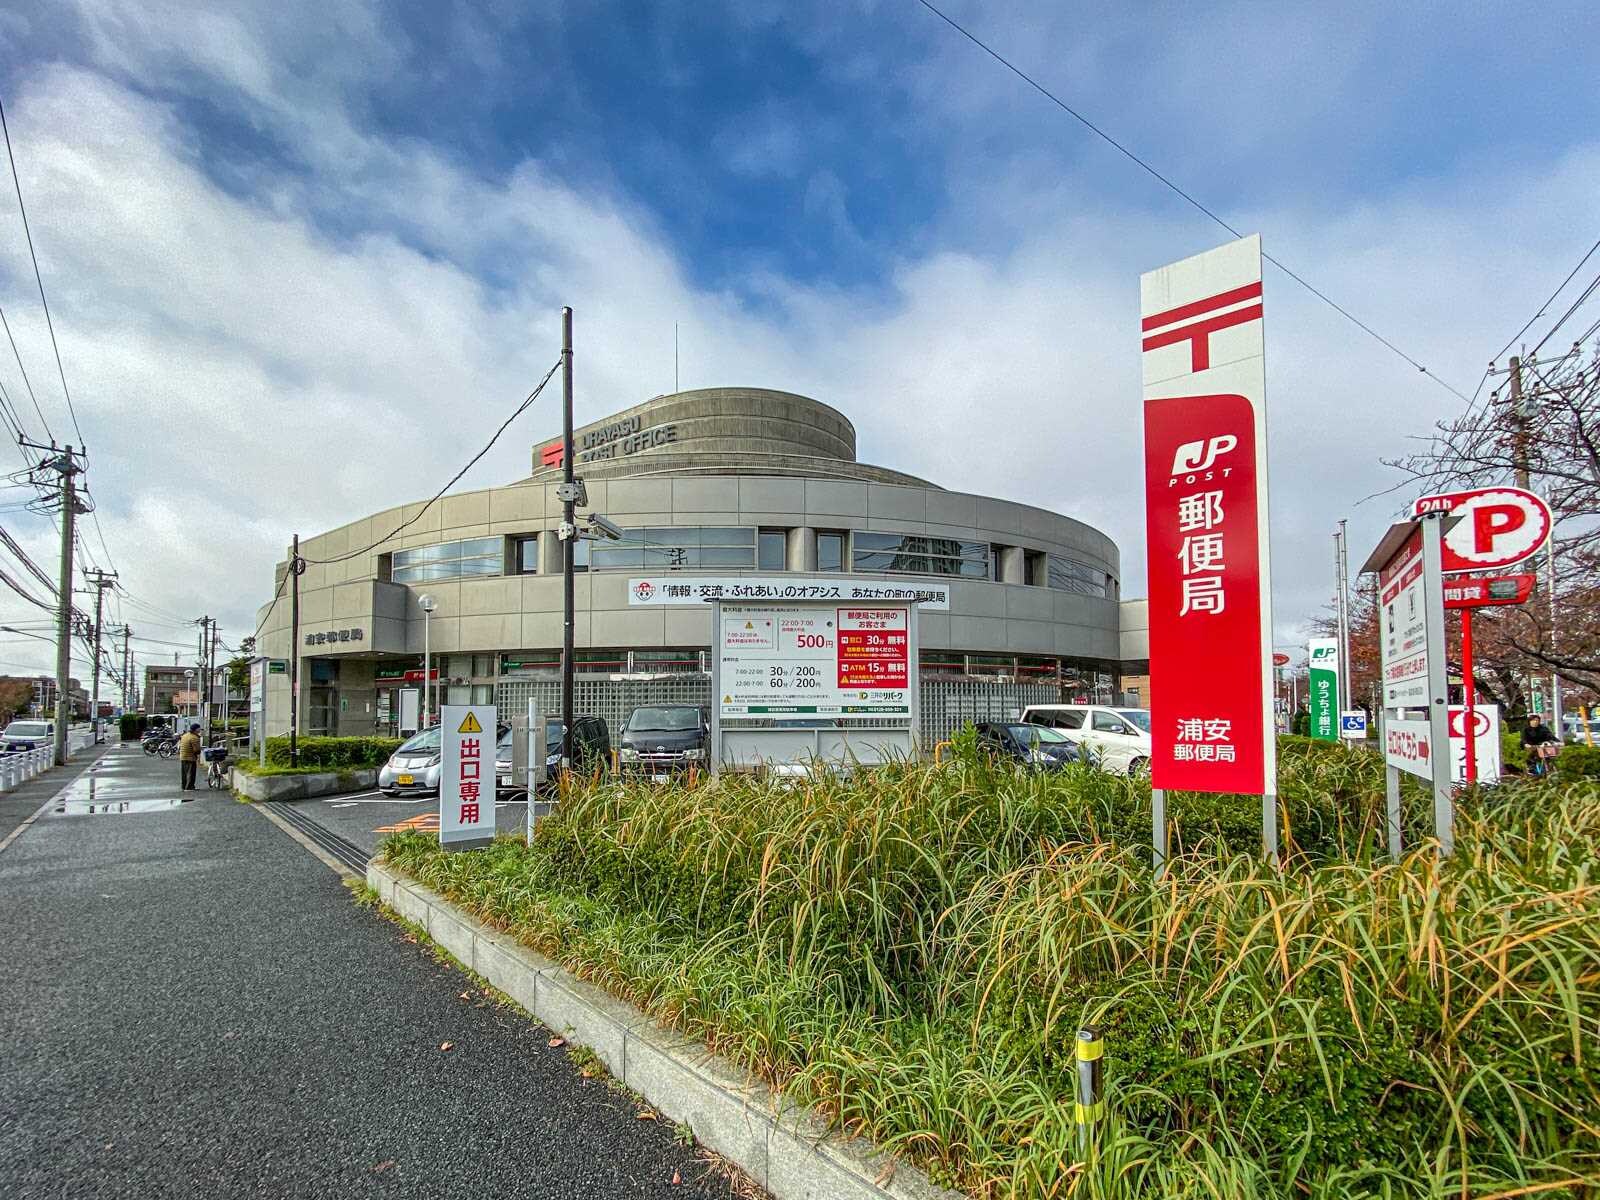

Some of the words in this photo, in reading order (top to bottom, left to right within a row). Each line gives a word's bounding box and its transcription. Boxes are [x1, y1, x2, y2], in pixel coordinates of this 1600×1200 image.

[583, 415, 641, 450] URAYASU
[623, 424, 678, 456] OFFICE
[1168, 467, 1233, 488] POST
[1473, 503, 1527, 555] P
[1177, 489, 1226, 617] 郵便局
[797, 634, 834, 648] 500円
[1318, 680, 1331, 736] ゆうちょ銀行
[1175, 718, 1232, 742] 浦安
[1387, 729, 1418, 761] 出口はこちら
[1173, 743, 1236, 762] 郵便局
[459, 738, 481, 824] 出口専用
